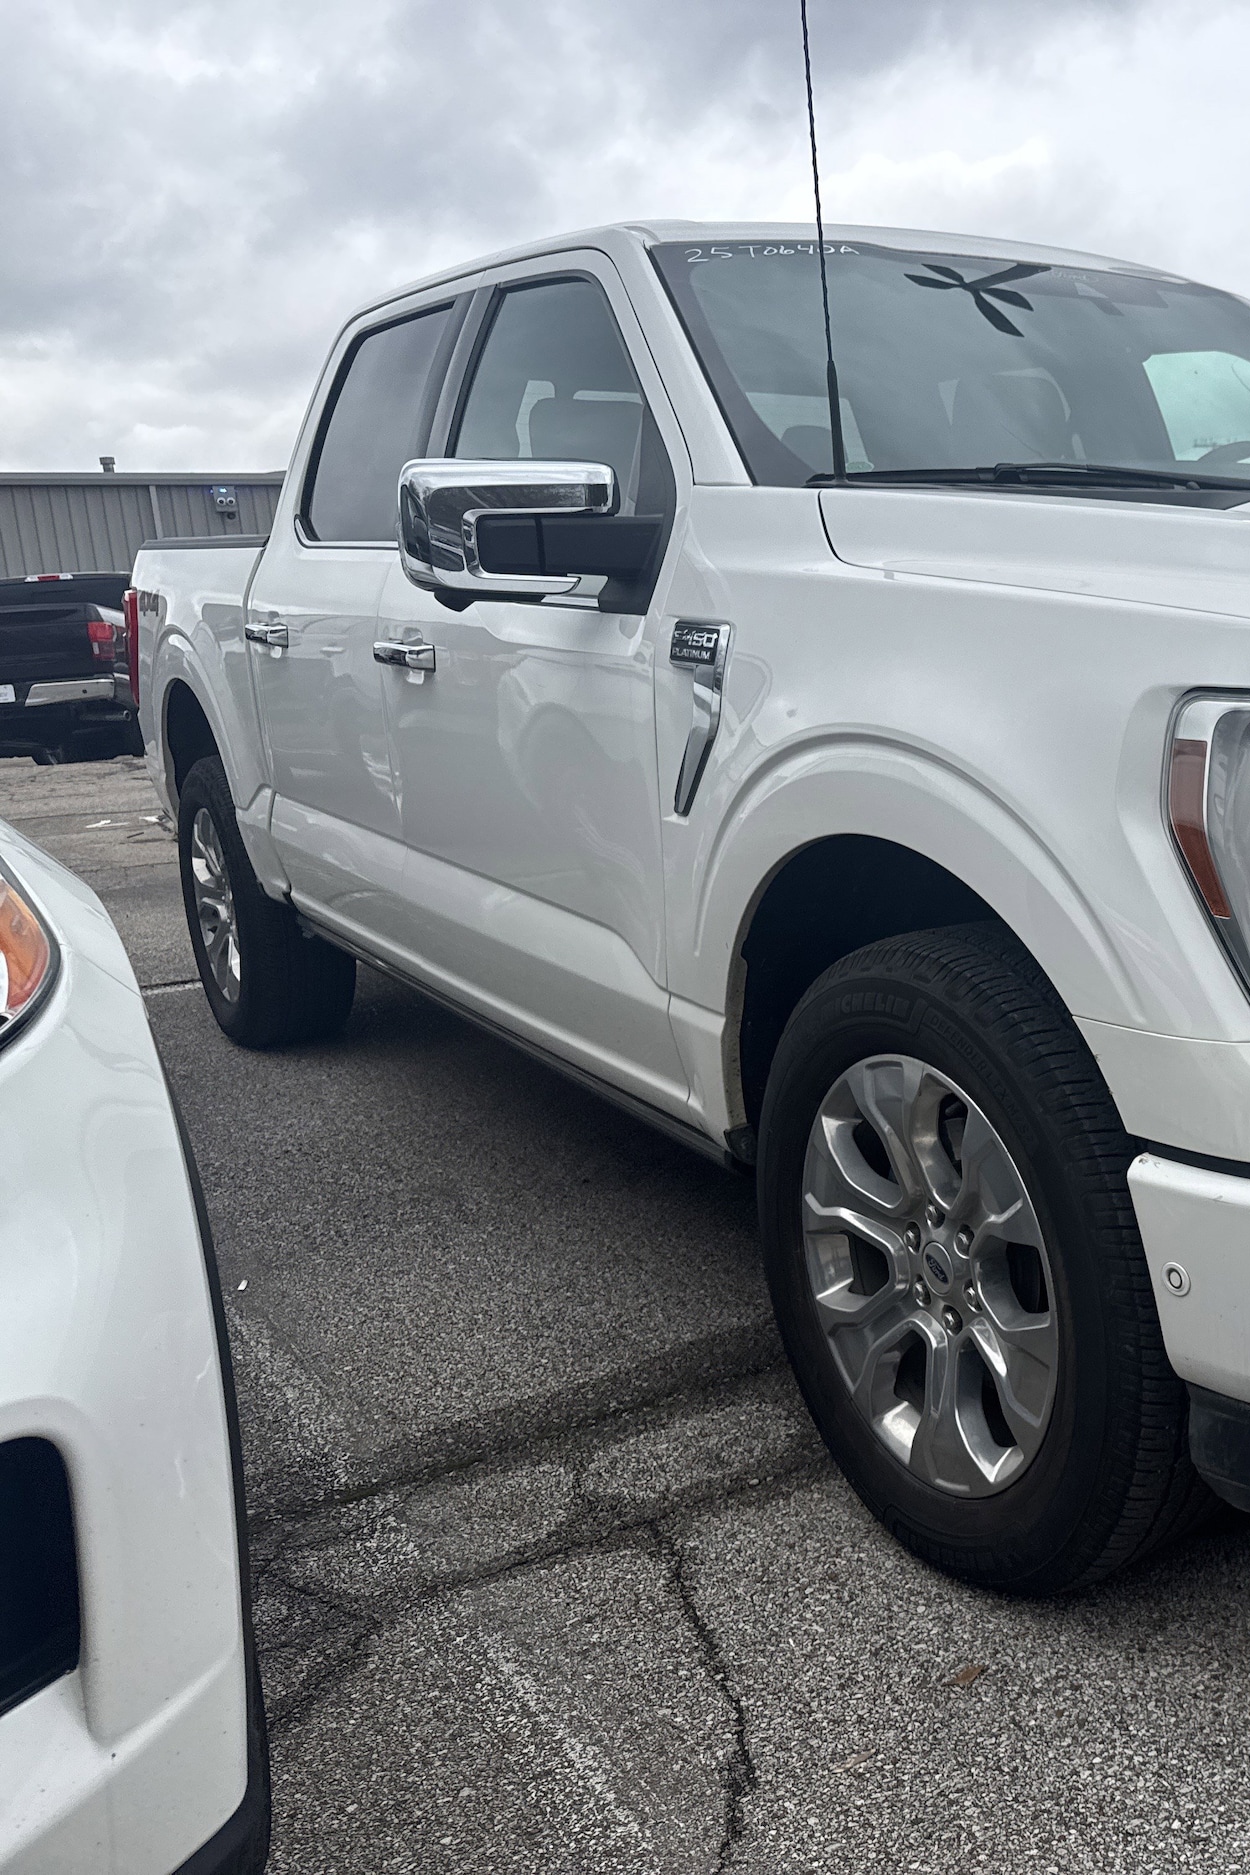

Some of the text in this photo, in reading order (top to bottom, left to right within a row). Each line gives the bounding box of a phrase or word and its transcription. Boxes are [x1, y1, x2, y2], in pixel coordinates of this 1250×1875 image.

[672, 648, 711, 660] PLATINUM
[820, 991, 911, 1024] MICHELIN
[929, 1013, 989, 1073] DEFENDER
[928, 1258, 945, 1281] Ford
